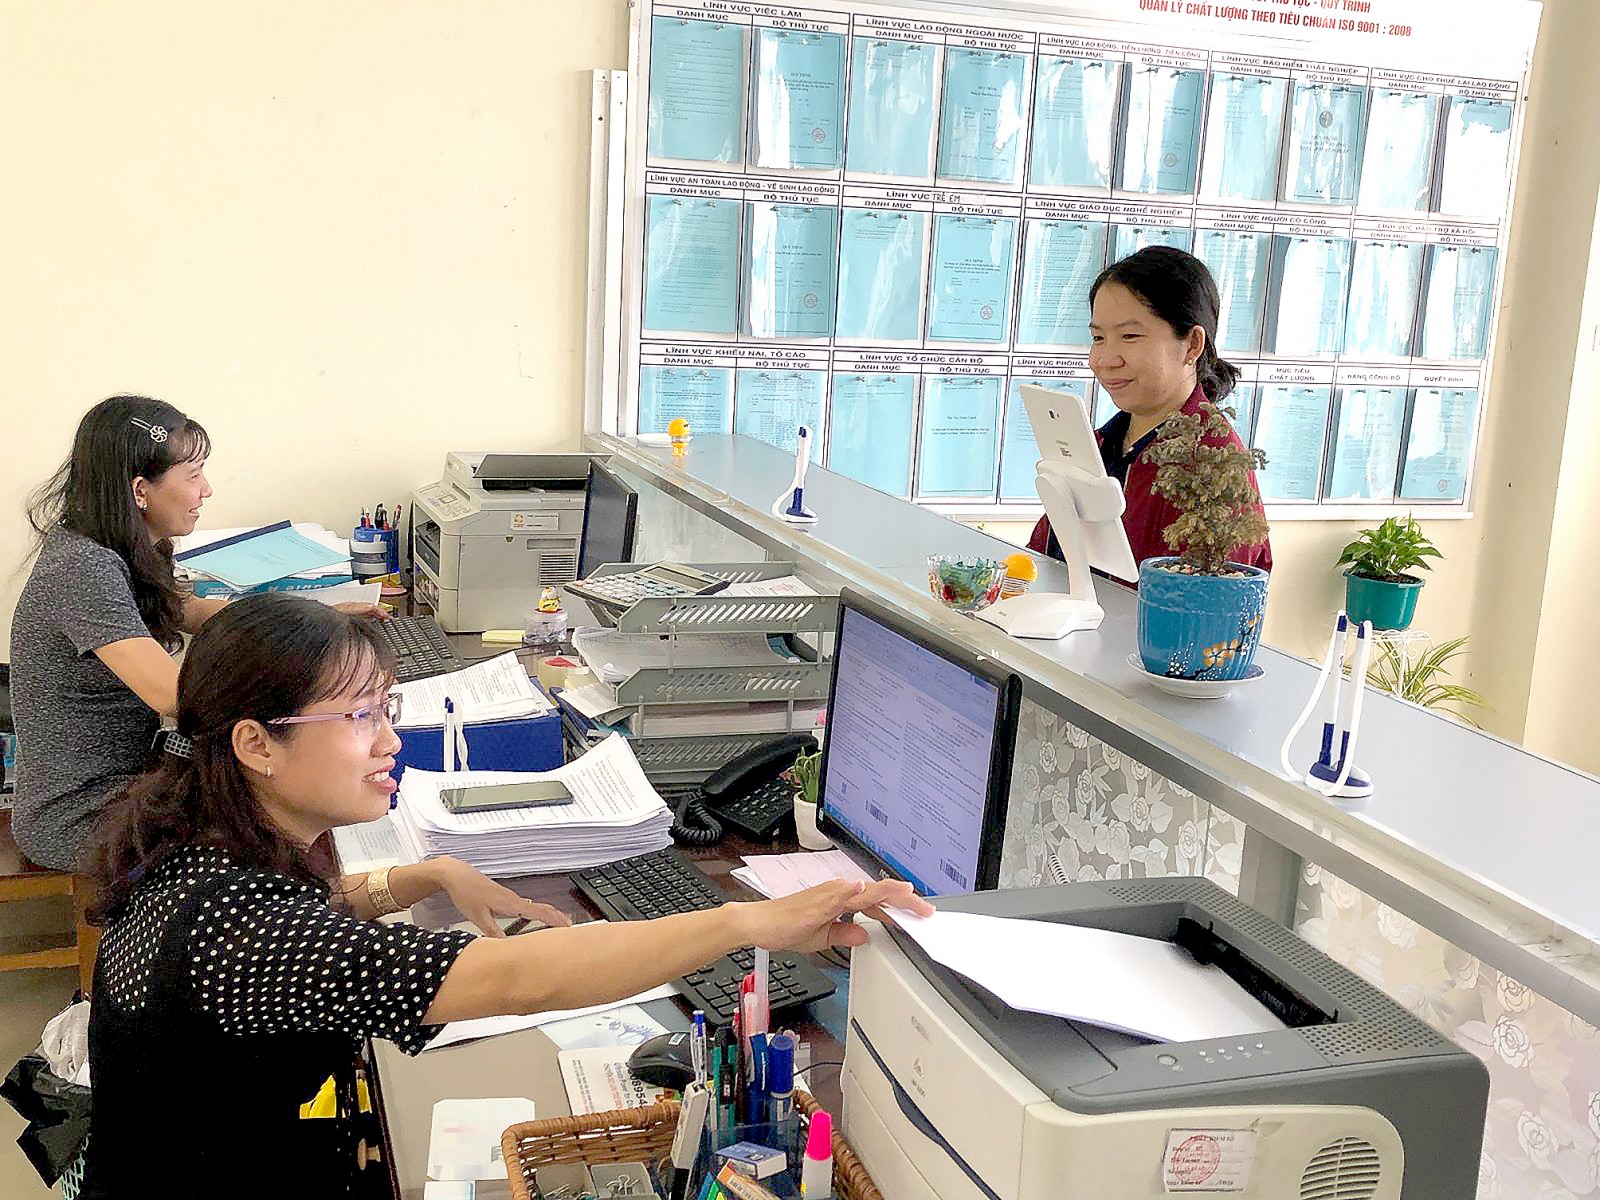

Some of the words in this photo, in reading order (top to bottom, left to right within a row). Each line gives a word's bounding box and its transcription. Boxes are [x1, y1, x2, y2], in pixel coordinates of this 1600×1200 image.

[703, 1, 727, 10] LĨNH
[731, 4, 751, 13] VỰC
[754, 7, 778, 15] VIỆC
[677, 10, 704, 18] DANH
[1186, 1, 1213, 16] CHẤT
[1215, 6, 1249, 21] LƯỢNG
[1251, 9, 1276, 23] THEO
[1279, 11, 1300, 26] TIÊU
[1338, 19, 1355, 31] ISO
[1357, 21, 1380, 34] 9001
[1388, 24, 1412, 37] 2008
[789, 22, 808, 30] THỦ
[914, 23, 933, 31] LAO
[875, 30, 901, 38] DANH
[1059, 48, 1084, 56] DANH
[650, 174, 669, 183] LĨNH
[670, 176, 686, 185] VỰC
[687, 177, 699, 185] AN
[722, 179, 738, 187] LAO
[739, 180, 761, 189] ĐỘNG
[779, 184, 797, 192] SINH
[798, 185, 812, 193] LAO
[813, 185, 836, 194] ĐỘNG
[670, 187, 697, 196] DANH
[886, 190, 908, 199] LĨNH
[864, 200, 890, 208] DANH
[1045, 211, 1069, 219] DANH
